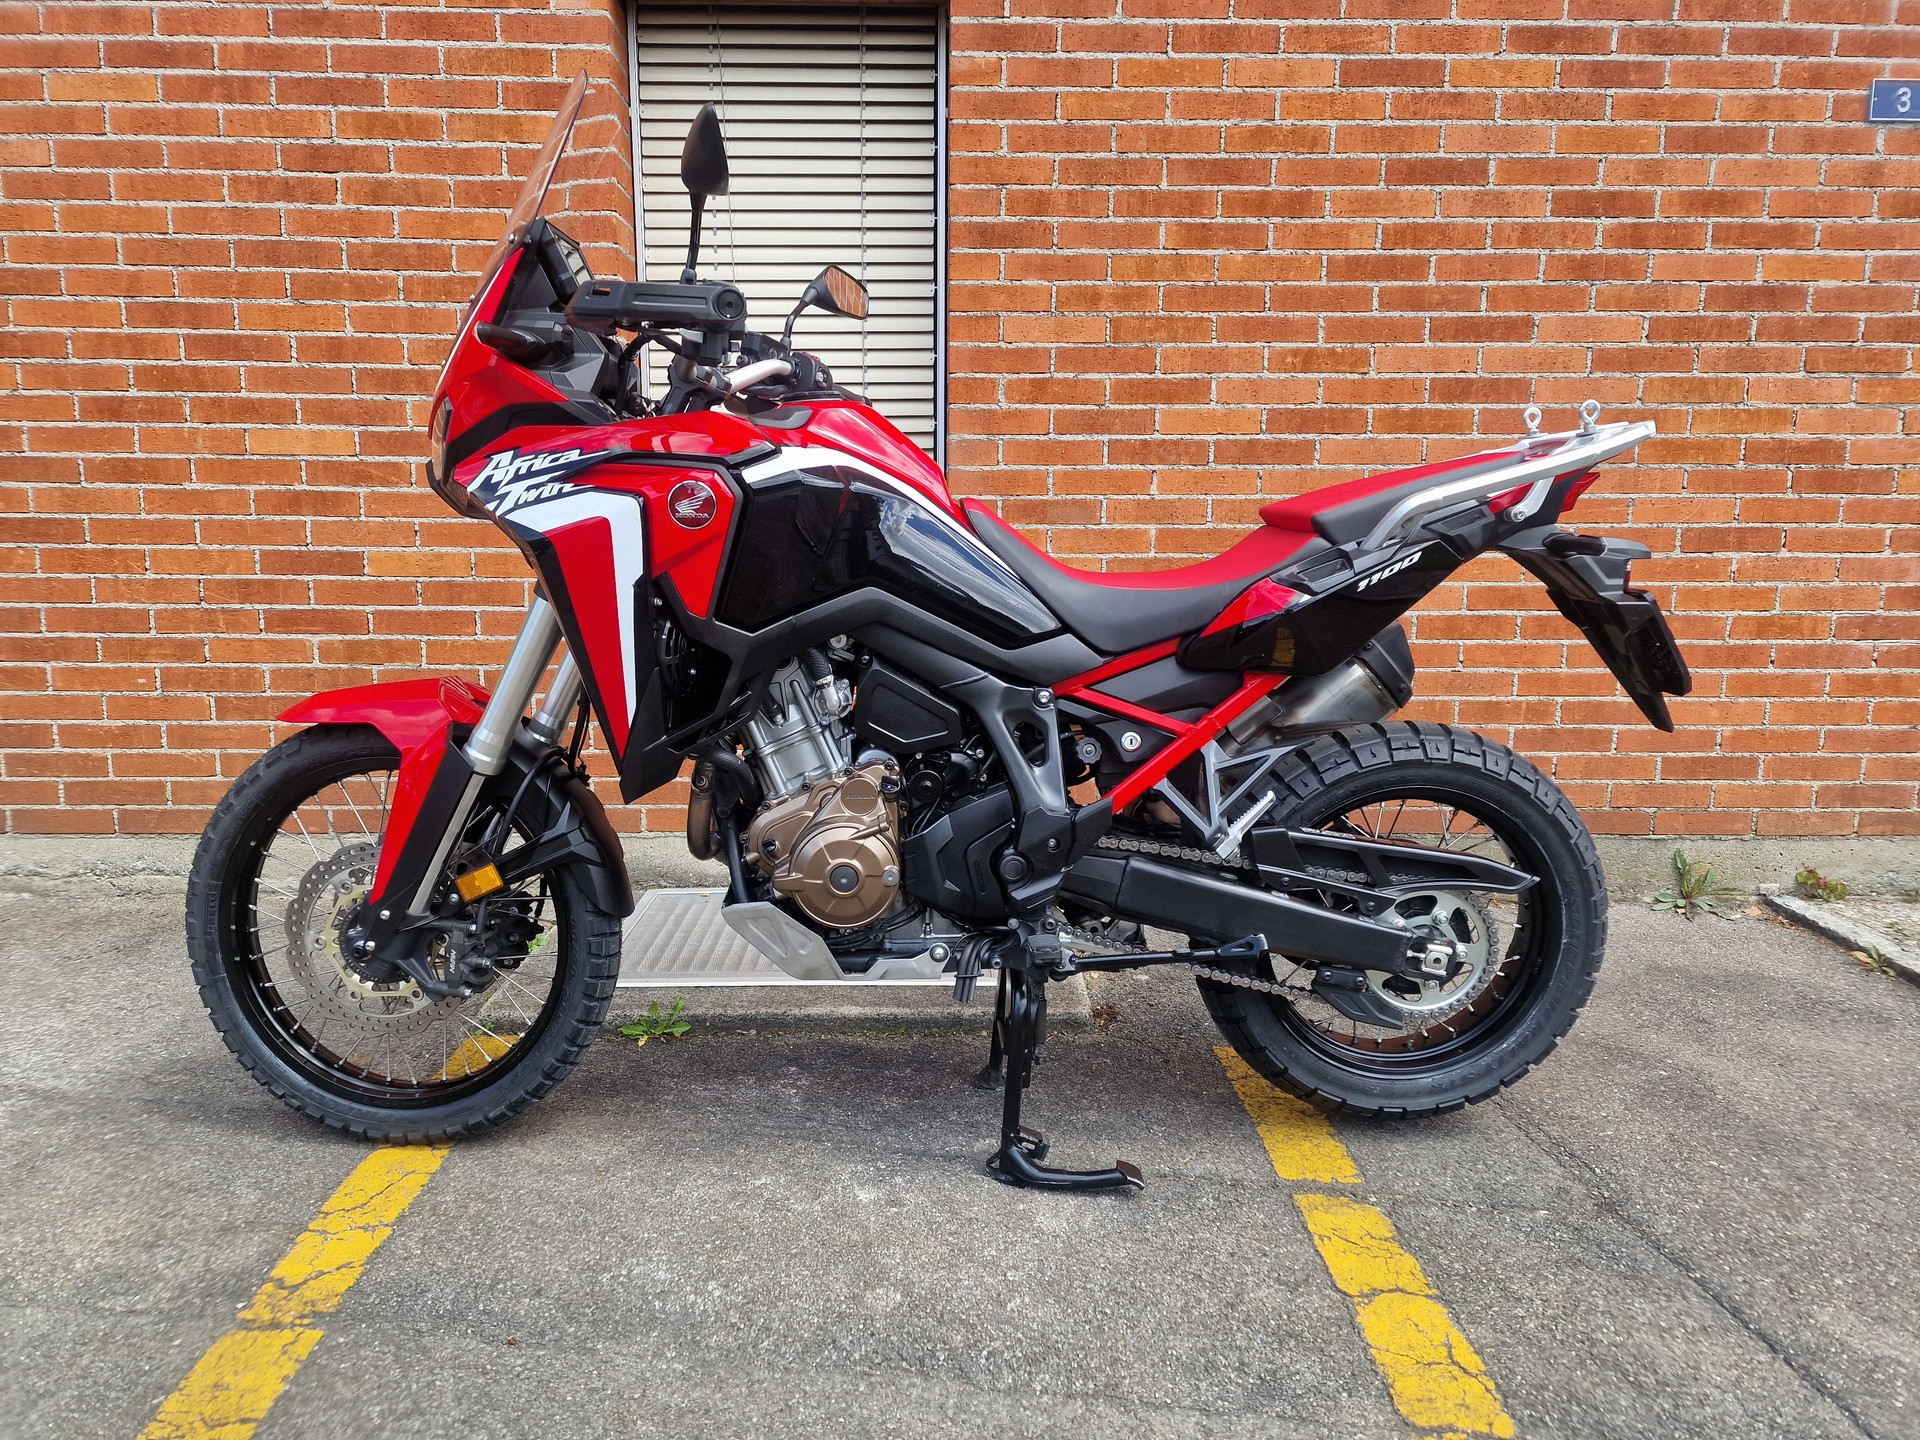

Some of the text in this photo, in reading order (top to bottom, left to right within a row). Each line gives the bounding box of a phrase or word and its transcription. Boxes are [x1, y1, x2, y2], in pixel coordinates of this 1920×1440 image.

[1897, 86, 1912, 113] 3
[468, 449, 611, 492] Africa
[485, 470, 596, 517] Twin
[1357, 551, 1422, 593] 1100
